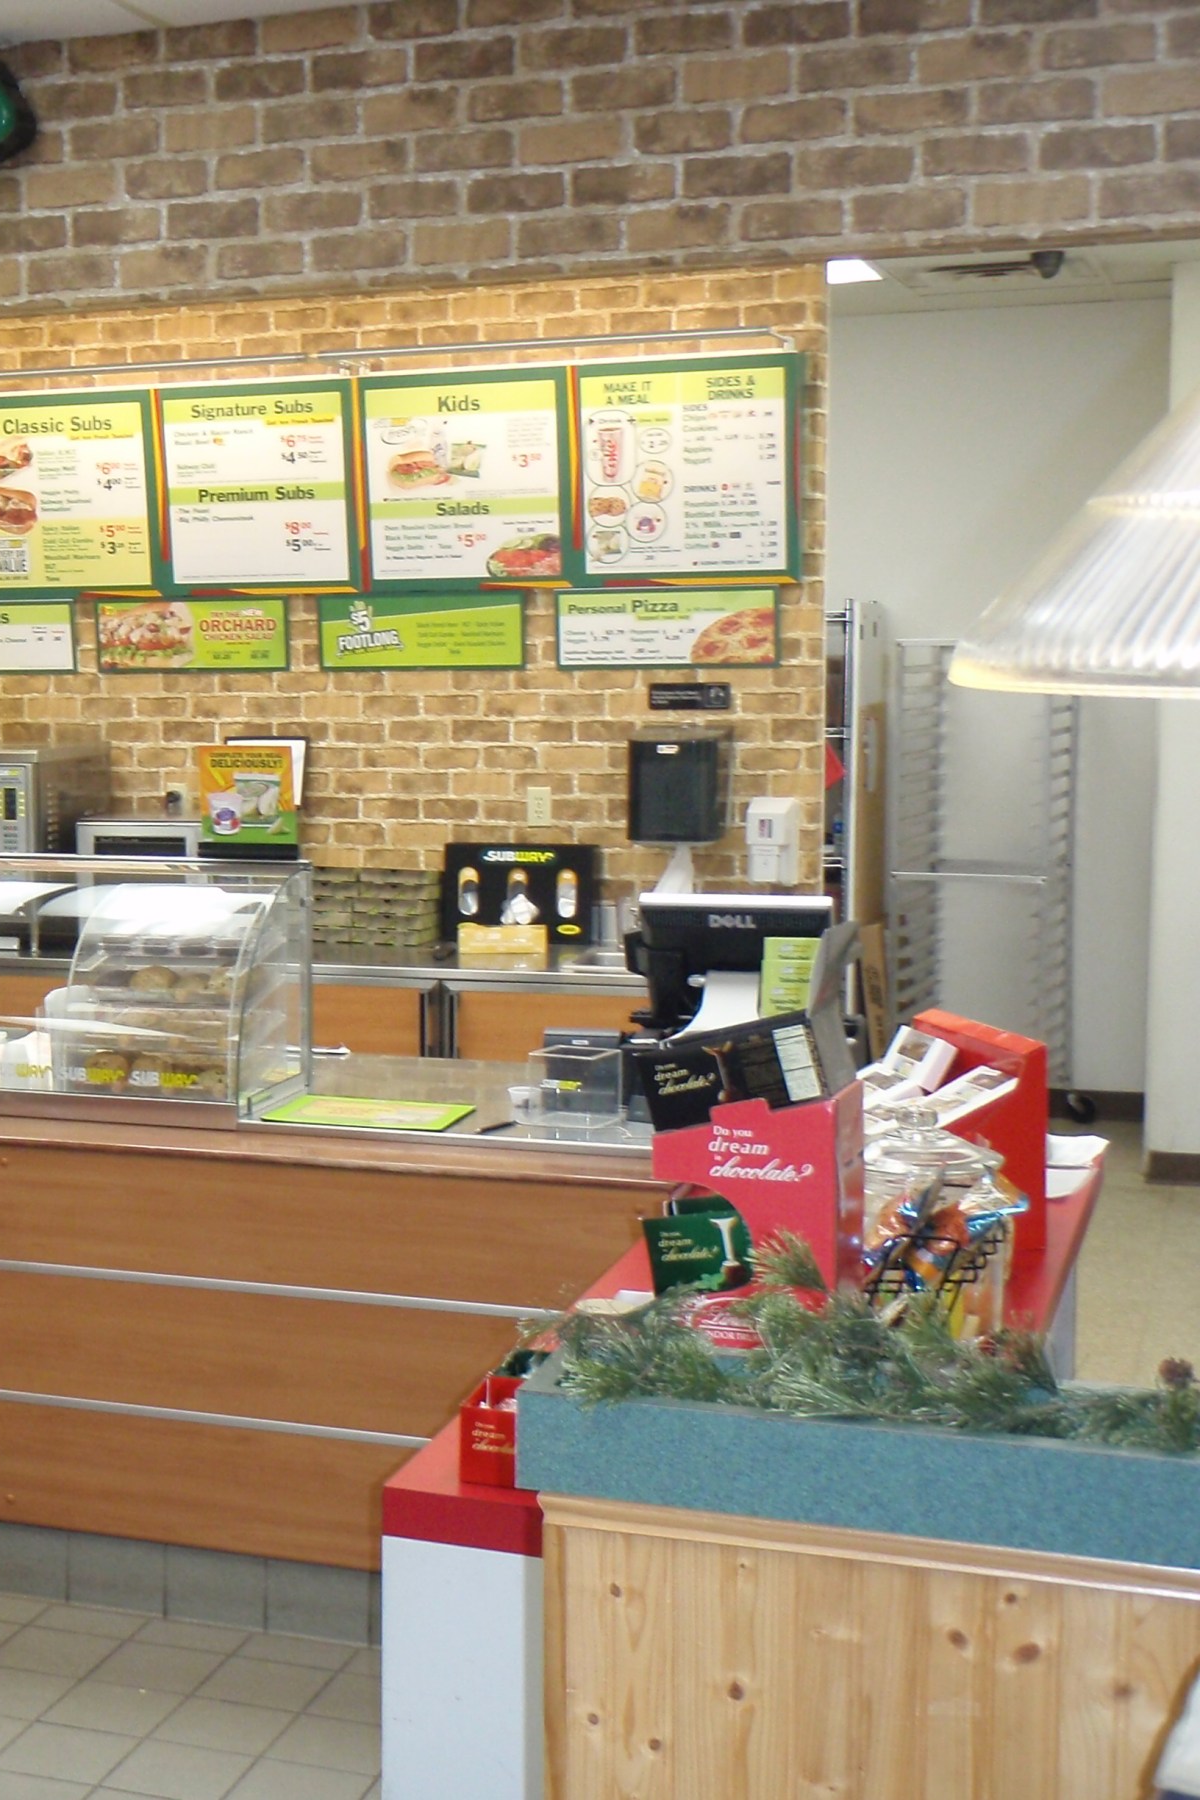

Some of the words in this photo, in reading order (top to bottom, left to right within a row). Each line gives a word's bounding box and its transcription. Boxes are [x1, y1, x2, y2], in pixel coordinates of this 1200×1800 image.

[604, 382, 636, 393] MAKE
[642, 381, 652, 391] IT
[707, 376, 741, 388] SIDES
[746, 376, 755, 385] &
[607, 396, 612, 405] A
[618, 394, 649, 404] MEAL
[709, 389, 753, 400] DRINKS
[191, 404, 266, 420] Signature
[274, 401, 313, 414] Subs
[438, 395, 480, 412] Kids
[3, 418, 64, 434] Classic
[70, 416, 111, 431] Subs
[199, 488, 268, 503] Premium
[275, 486, 315, 500] Subs
[436, 502, 489, 516] Salads
[568, 604, 626, 614] Personal
[631, 600, 679, 613] Pizza
[200, 619, 277, 631] ORCHARD
[351, 610, 370, 631] $5
[338, 630, 398, 651] FOOTLONG
[210, 759, 283, 768] DELICIOUSLY!
[482, 850, 555, 863] SUBWAY
[708, 914, 757, 928] DELL
[128, 1069, 199, 1088] SUBWAY
[655, 1069, 688, 1081] dream
[713, 1126, 730, 1136] Do
[733, 1128, 752, 1138] you
[709, 1137, 769, 1155] dream
[709, 1157, 814, 1182] chocolate?
[658, 1239, 693, 1248] dream
[472, 1428, 506, 1439] dream
